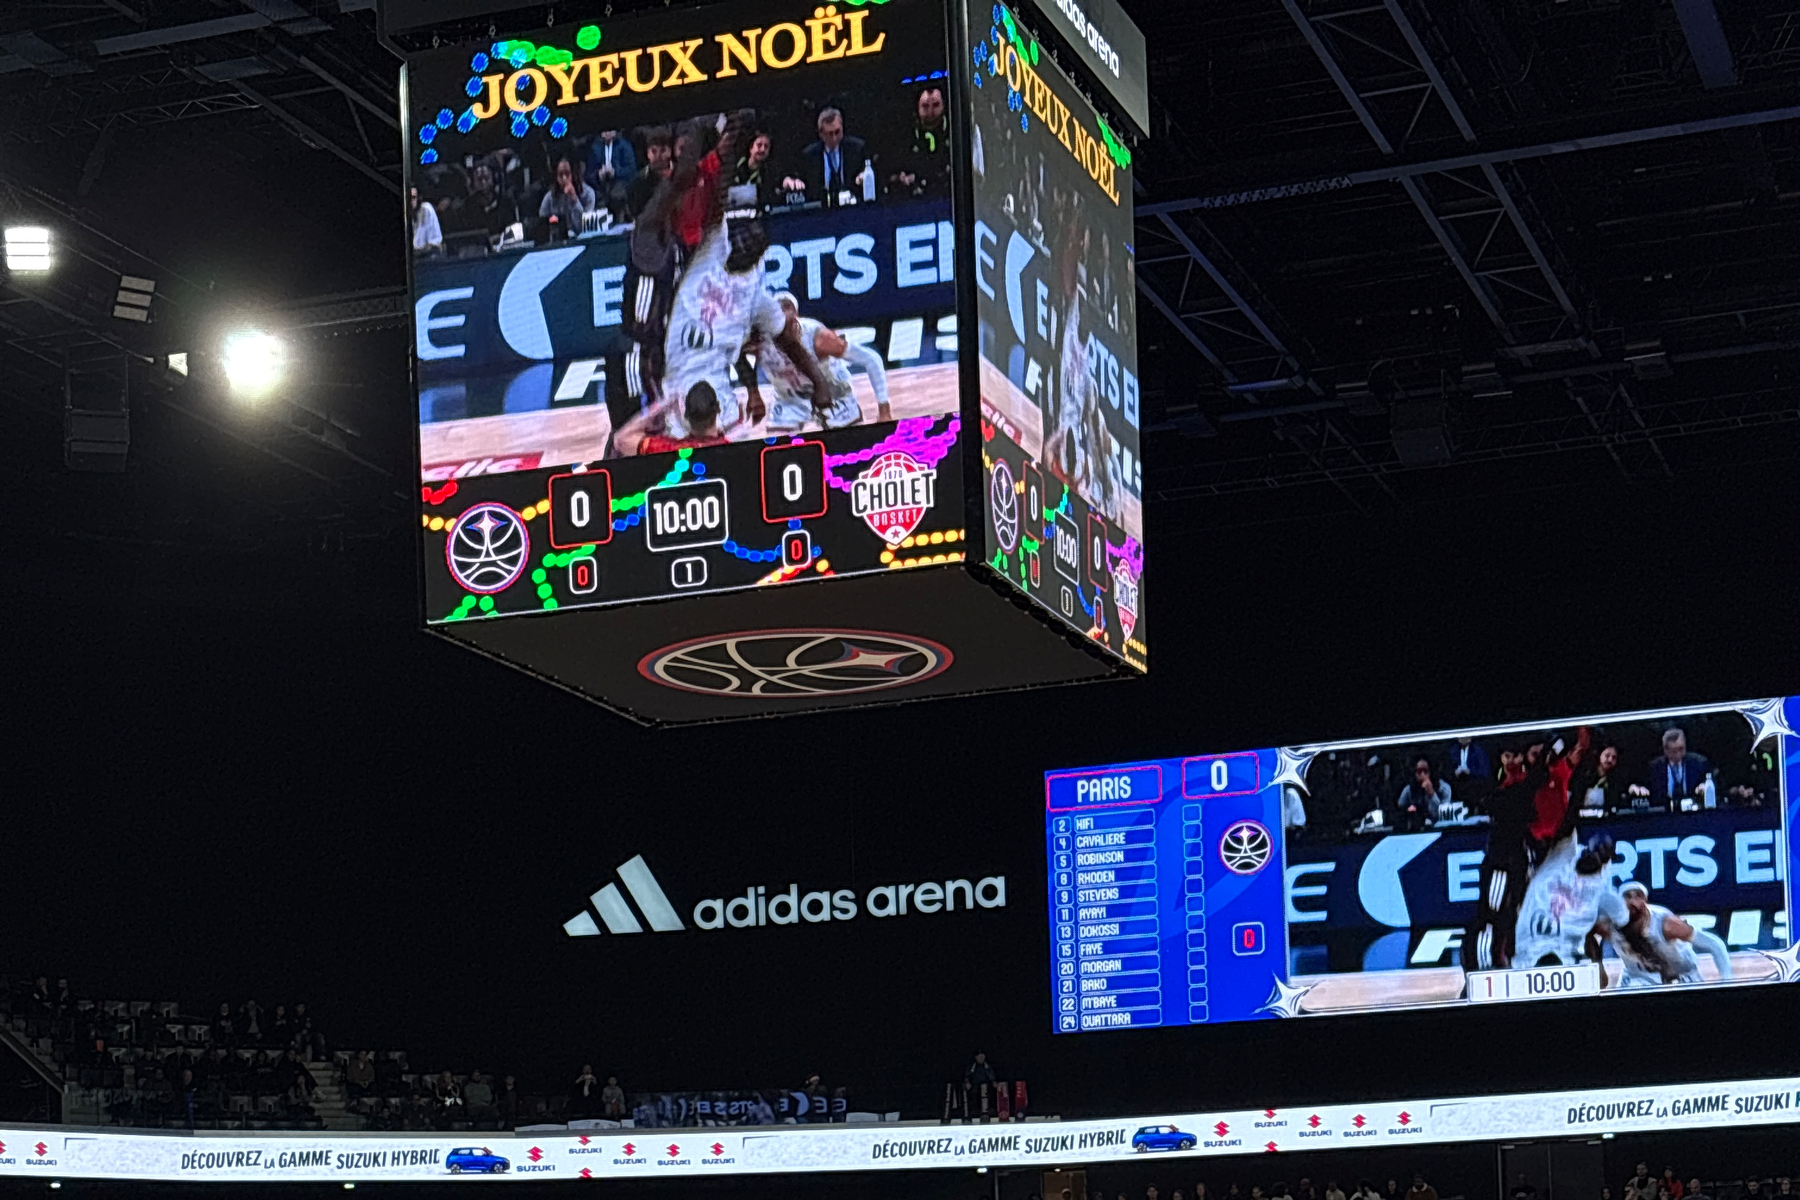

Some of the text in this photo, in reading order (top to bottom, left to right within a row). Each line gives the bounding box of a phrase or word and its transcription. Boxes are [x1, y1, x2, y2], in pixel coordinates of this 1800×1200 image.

[1087, 22, 1119, 78] arena
[472, 5, 886, 119] JOYEUX NOËL
[994, 32, 1120, 206] JOYEUX NOËL
[783, 463, 803, 501] 0
[853, 472, 935, 514] CHOLET
[570, 490, 590, 527] 0
[653, 496, 720, 535] 10:00
[873, 507, 919, 527] BASKET
[791, 539, 803, 560] 0
[1056, 525, 1077, 569] 10:00
[576, 565, 589, 586] 0
[684, 562, 693, 583] 1
[1210, 760, 1228, 791] 0
[1077, 776, 1132, 803] PARIS
[1058, 817, 1094, 832] 2 HIFI
[1059, 832, 1126, 849] 4 CAVALIERE
[1060, 851, 1124, 868] 5 ROBINSON
[1060, 870, 1115, 885] 8 RHODEN
[693, 875, 1007, 930] adidas arena
[1061, 888, 1120, 903] 9 STEVENS
[1061, 906, 1107, 921] 11 AYAYI
[1061, 923, 1120, 939] 13 DOKOSSI
[1243, 928, 1255, 949] 0
[1061, 942, 1103, 957] 15 FAYE
[1061, 959, 1122, 975] 20 MORGAN
[1062, 978, 1107, 992] 21 BAKO
[1525, 971, 1576, 993] 10:00
[1062, 998, 1075, 1011] 22
[1063, 1012, 1131, 1028] 24 OUATTARA
[1567, 1099, 1655, 1124] DÉCOUVREZ
[1656, 1107, 1668, 1118] LA
[1671, 1093, 1730, 1116] GAMME
[1734, 1092, 1791, 1114] SUZUKI
[1254, 1120, 1287, 1128] SUZUKI
[1388, 1127, 1422, 1135] SUZUKI
[1298, 1129, 1332, 1137] SUZUKI
[1343, 1129, 1377, 1137] SUZUKI
[872, 1137, 953, 1159] DÉCOUVREZ
[954, 1145, 966, 1156] LA
[968, 1135, 1021, 1154] GAMME
[1025, 1134, 1074, 1154] SUZUKI
[1203, 1139, 1242, 1148] SUZUKI
[26, 1158, 57, 1166] SUZUKI
[181, 1149, 263, 1170] DÉCOUVREZ
[264, 1158, 276, 1169] LA
[278, 1149, 333, 1168] GAMME
[336, 1151, 387, 1170] SUZUKI
[516, 1164, 556, 1172] SUZUKI
[613, 1157, 647, 1165] SUZUKI
[657, 1158, 691, 1166] SUZUKI
[701, 1157, 735, 1165] SUZUKI
